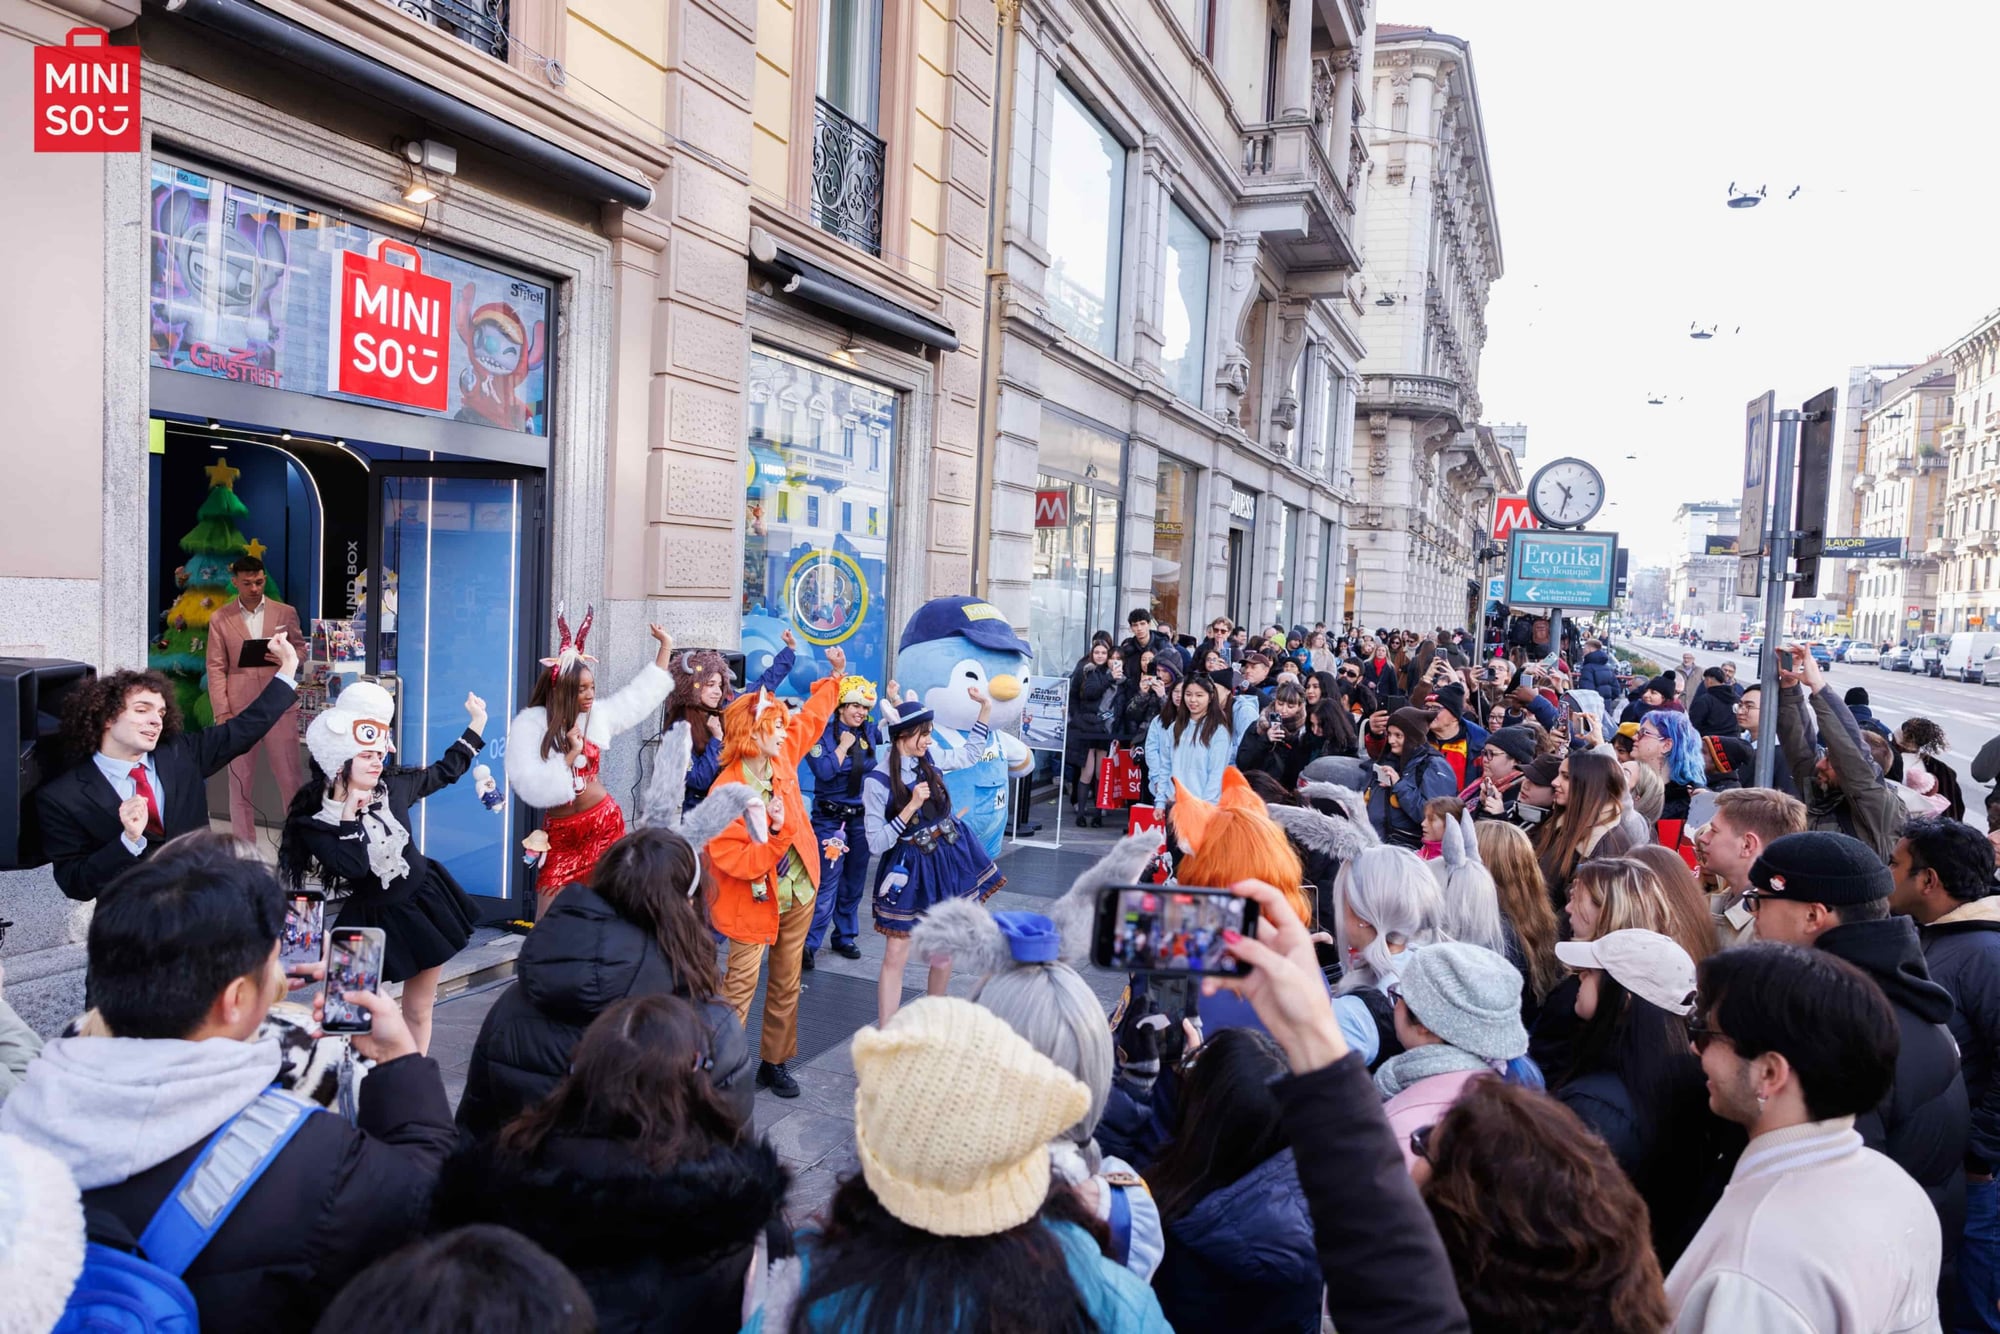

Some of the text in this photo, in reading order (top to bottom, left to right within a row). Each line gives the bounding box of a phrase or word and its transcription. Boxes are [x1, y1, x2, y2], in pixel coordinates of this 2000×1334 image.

[355, 277, 440, 338] MINI
[226, 361, 283, 389] STREET
[1525, 544, 1600, 567] Erotika
[1825, 538, 1866, 548] LAVORI
[346, 541, 359, 575] BOX
[1531, 565, 1591, 577] Sexy Boutique
